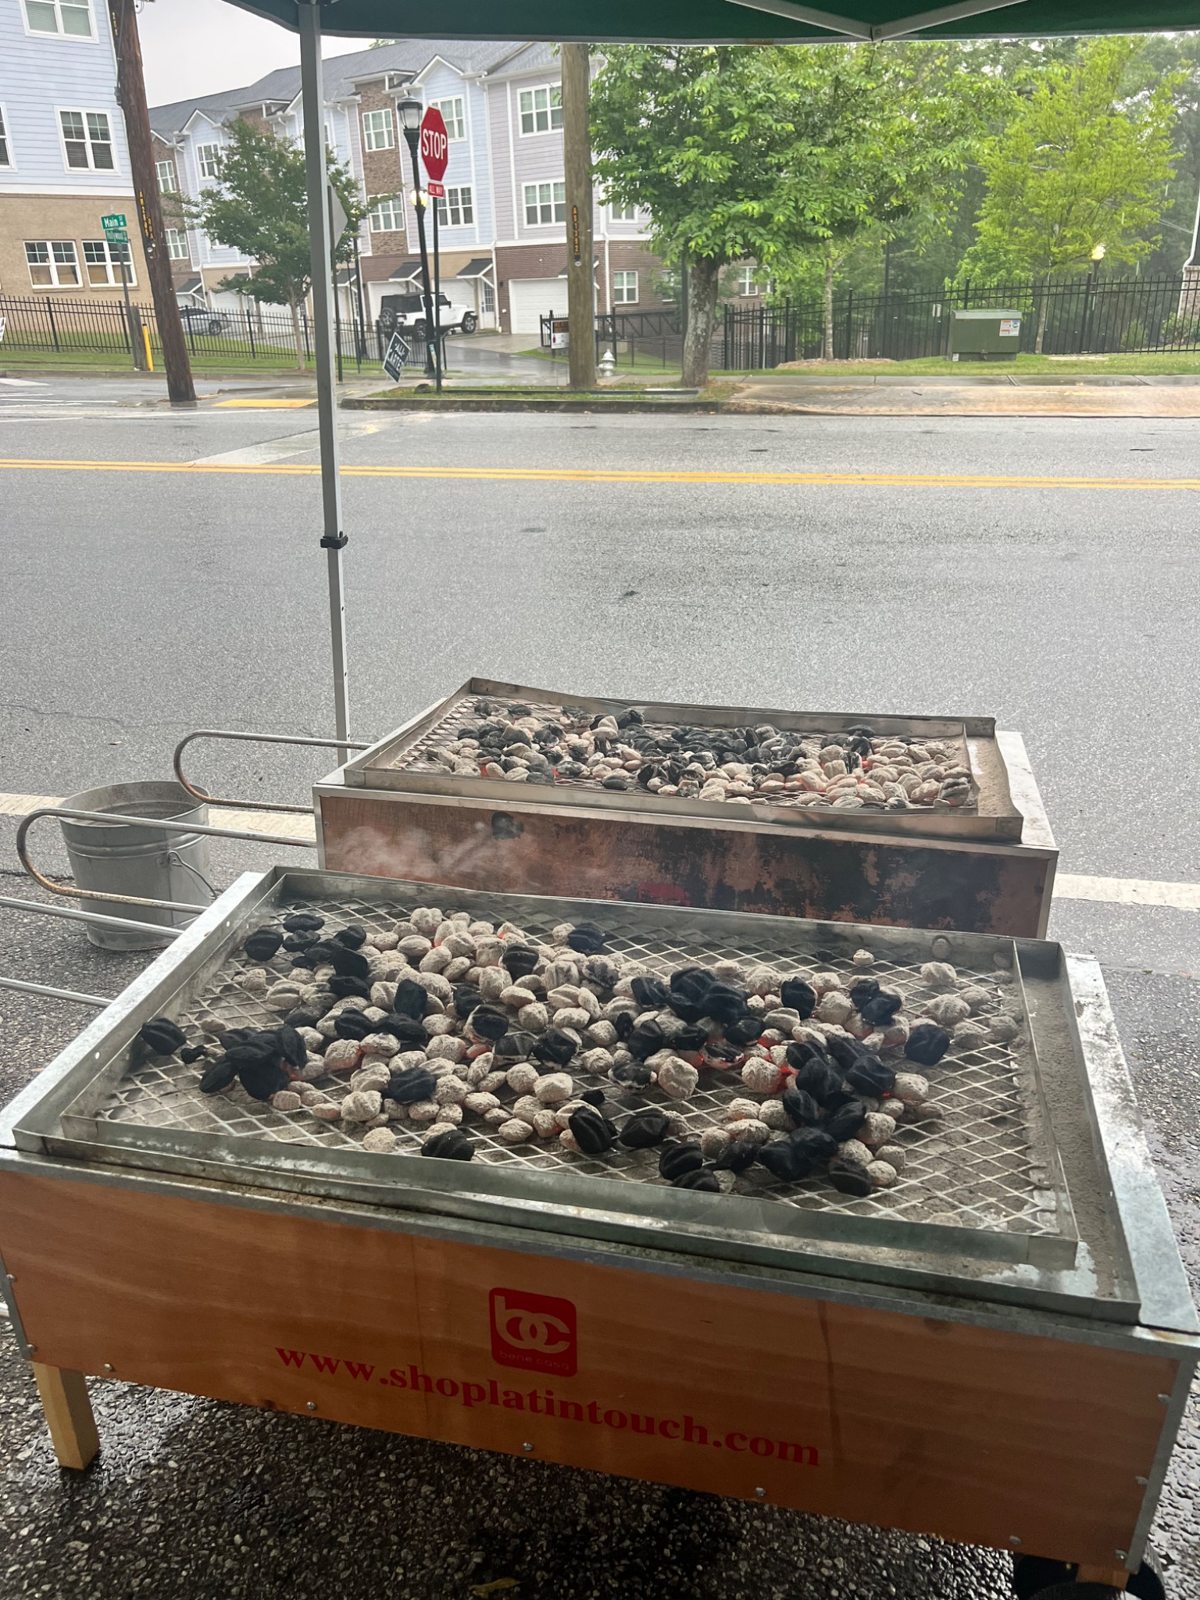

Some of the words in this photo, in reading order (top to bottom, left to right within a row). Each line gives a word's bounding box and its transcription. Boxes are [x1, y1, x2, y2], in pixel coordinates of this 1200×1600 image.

[422, 128, 447, 160] STOP
[103, 217, 119, 228] Main
[275, 1347, 820, 1467] www.shoplatintouch.com
